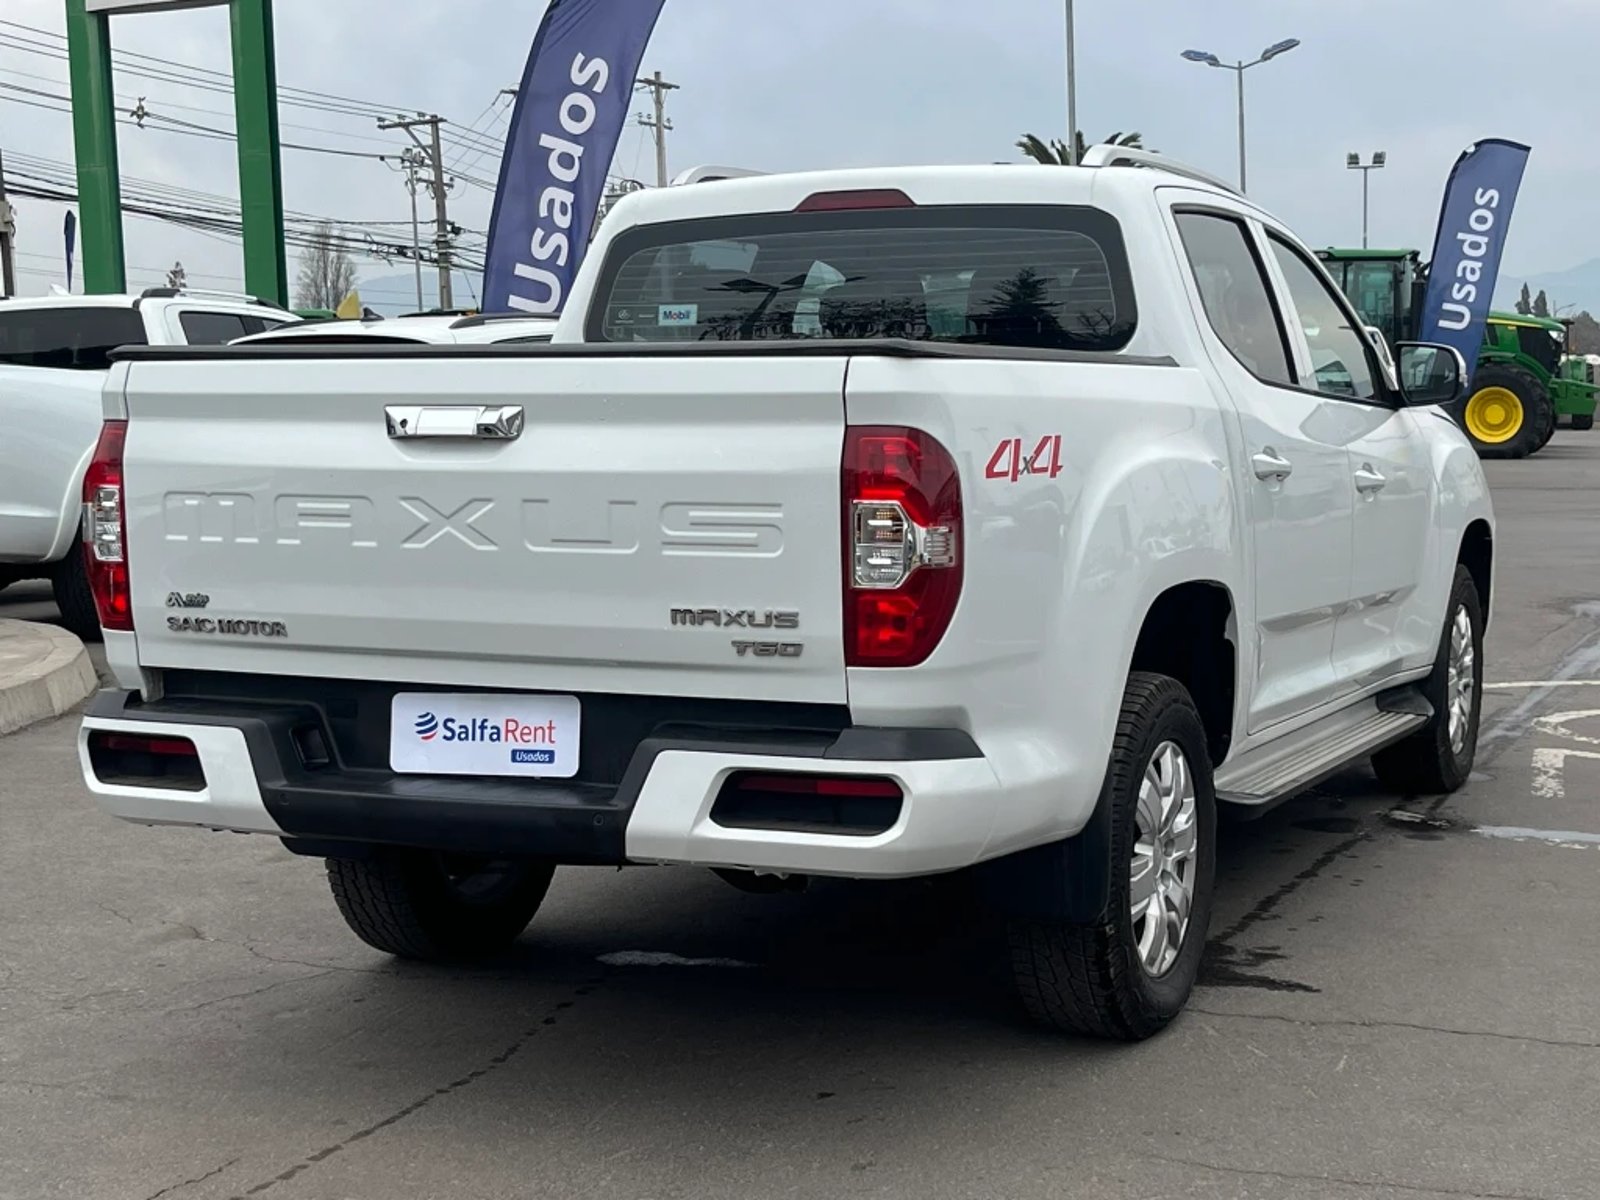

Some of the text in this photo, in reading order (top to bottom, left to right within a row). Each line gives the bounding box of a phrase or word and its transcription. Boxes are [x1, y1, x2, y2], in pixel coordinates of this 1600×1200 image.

[507, 52, 609, 313] Usados
[1438, 187, 1499, 331] Usados
[663, 310, 691, 320] Mobil
[985, 435, 1063, 482] 4x4
[164, 491, 785, 560] MAXUS
[167, 617, 288, 637] SAIC MOTOR
[670, 608, 800, 628] MAXUS
[731, 640, 804, 657] T60
[443, 717, 556, 744] SalfaRent
[515, 750, 551, 762] Usados
